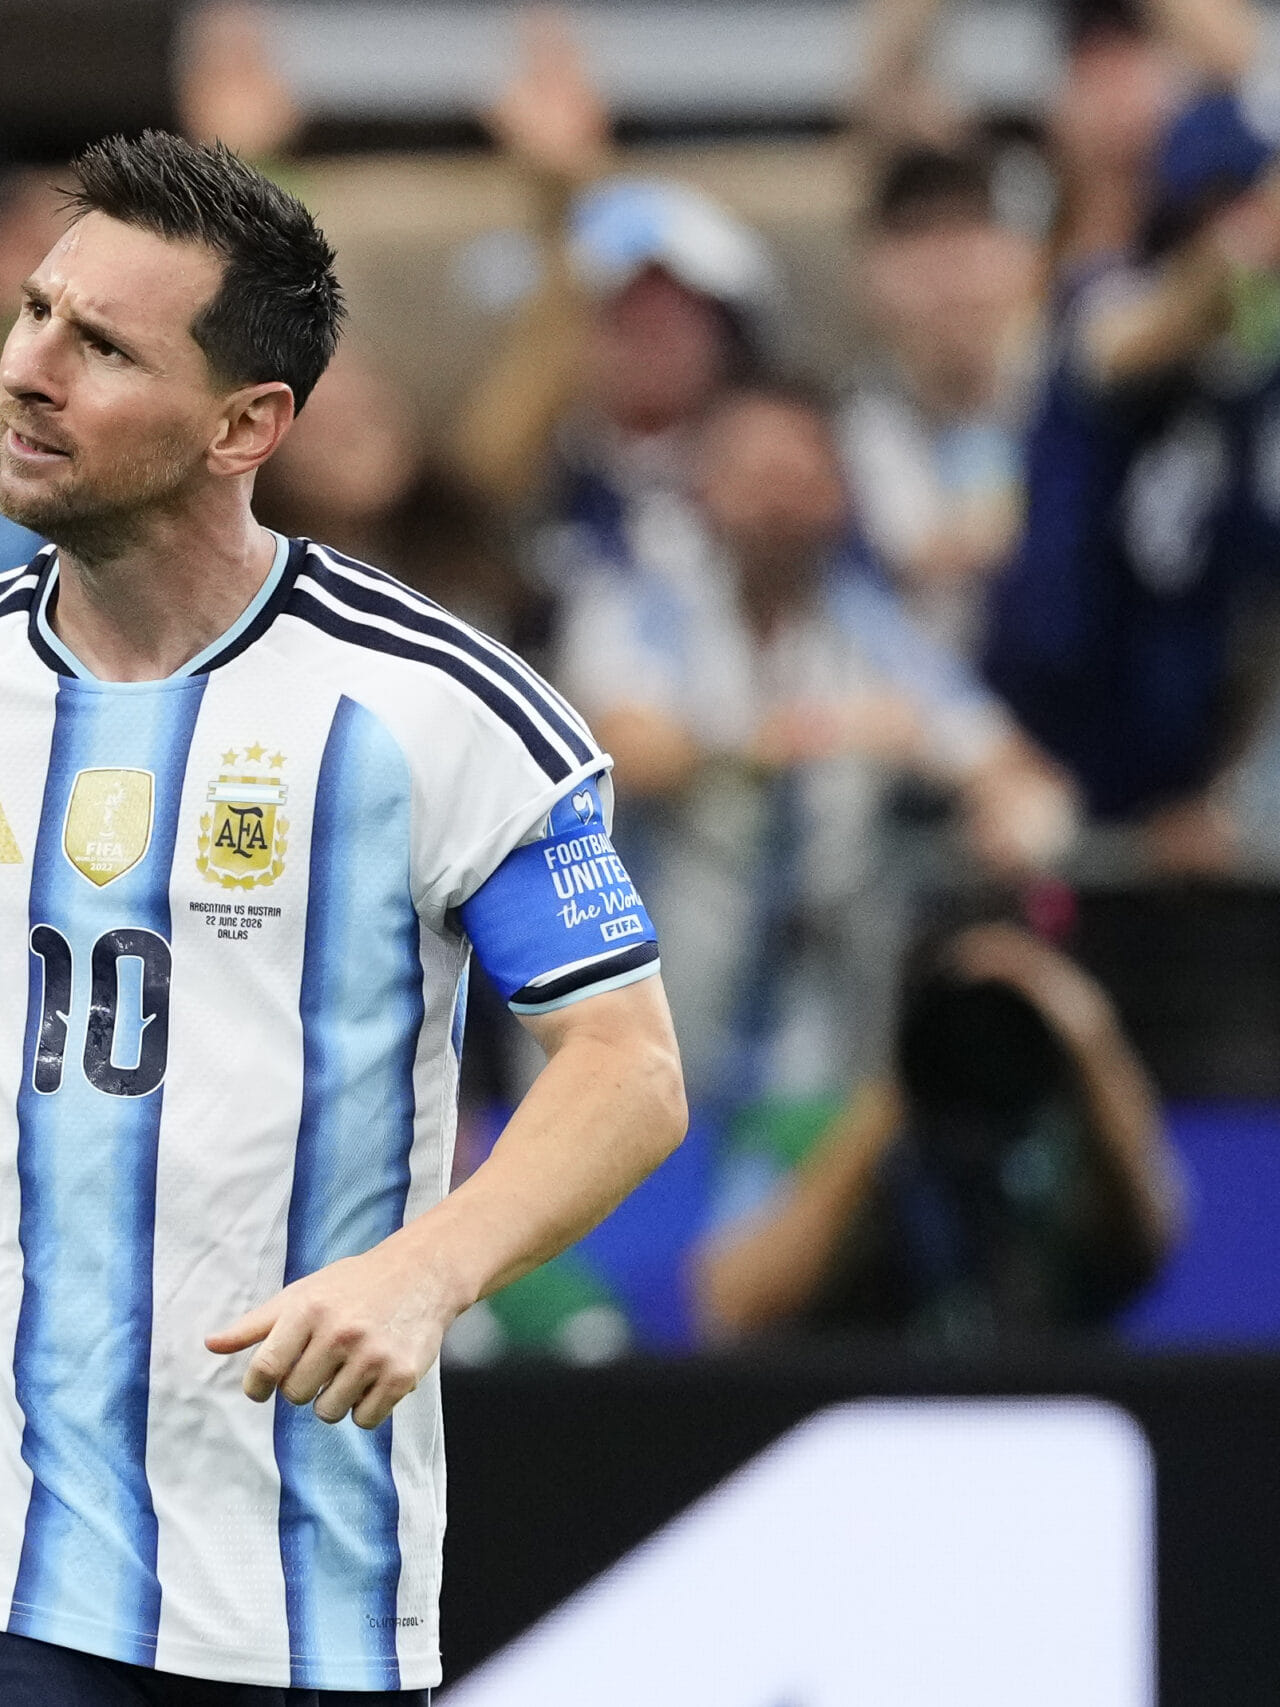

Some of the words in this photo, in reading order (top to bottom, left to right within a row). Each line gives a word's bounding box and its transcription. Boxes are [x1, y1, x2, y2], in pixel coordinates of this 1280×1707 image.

[215, 804, 268, 858] AFA
[86, 842, 124, 858] FIFA
[544, 833, 616, 870] FOOTBAL
[90, 863, 113, 872] 2022
[189, 902, 231, 914] ARGENTINA
[248, 905, 282, 917] AUSTRIA
[556, 899, 600, 928] the
[206, 915, 216, 926] 22
[219, 917, 238, 927] JUNE
[240, 918, 263, 929] 2026
[605, 919, 639, 937] FIFA
[217, 929, 249, 940] DALLAS
[30, 924, 173, 1098] 10
